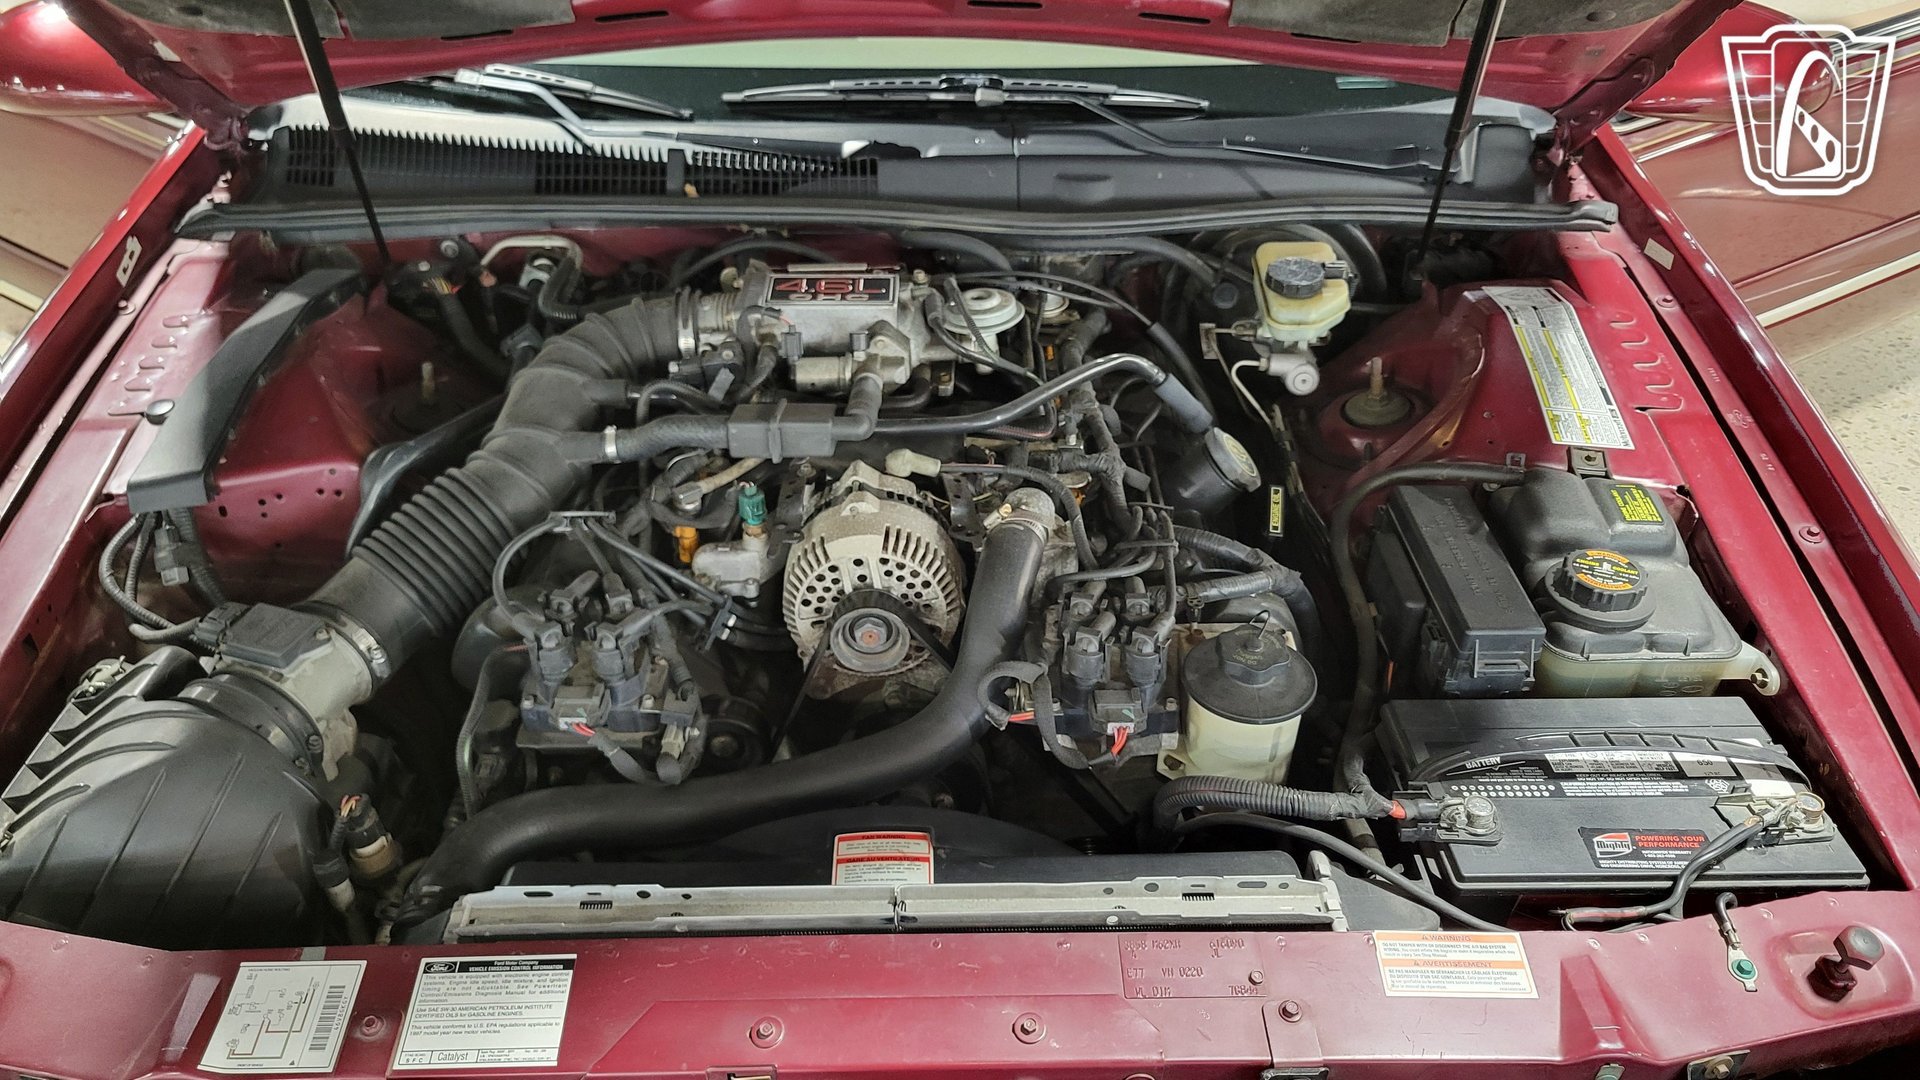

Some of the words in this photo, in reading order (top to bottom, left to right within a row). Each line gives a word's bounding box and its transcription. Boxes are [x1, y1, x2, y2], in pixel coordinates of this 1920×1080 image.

[775, 278, 887, 293] 4.6L
[1465, 757, 1500, 769] BATTERY
[1596, 840, 1631, 850] Mighty
[437, 1052, 468, 1062] Catalyst
